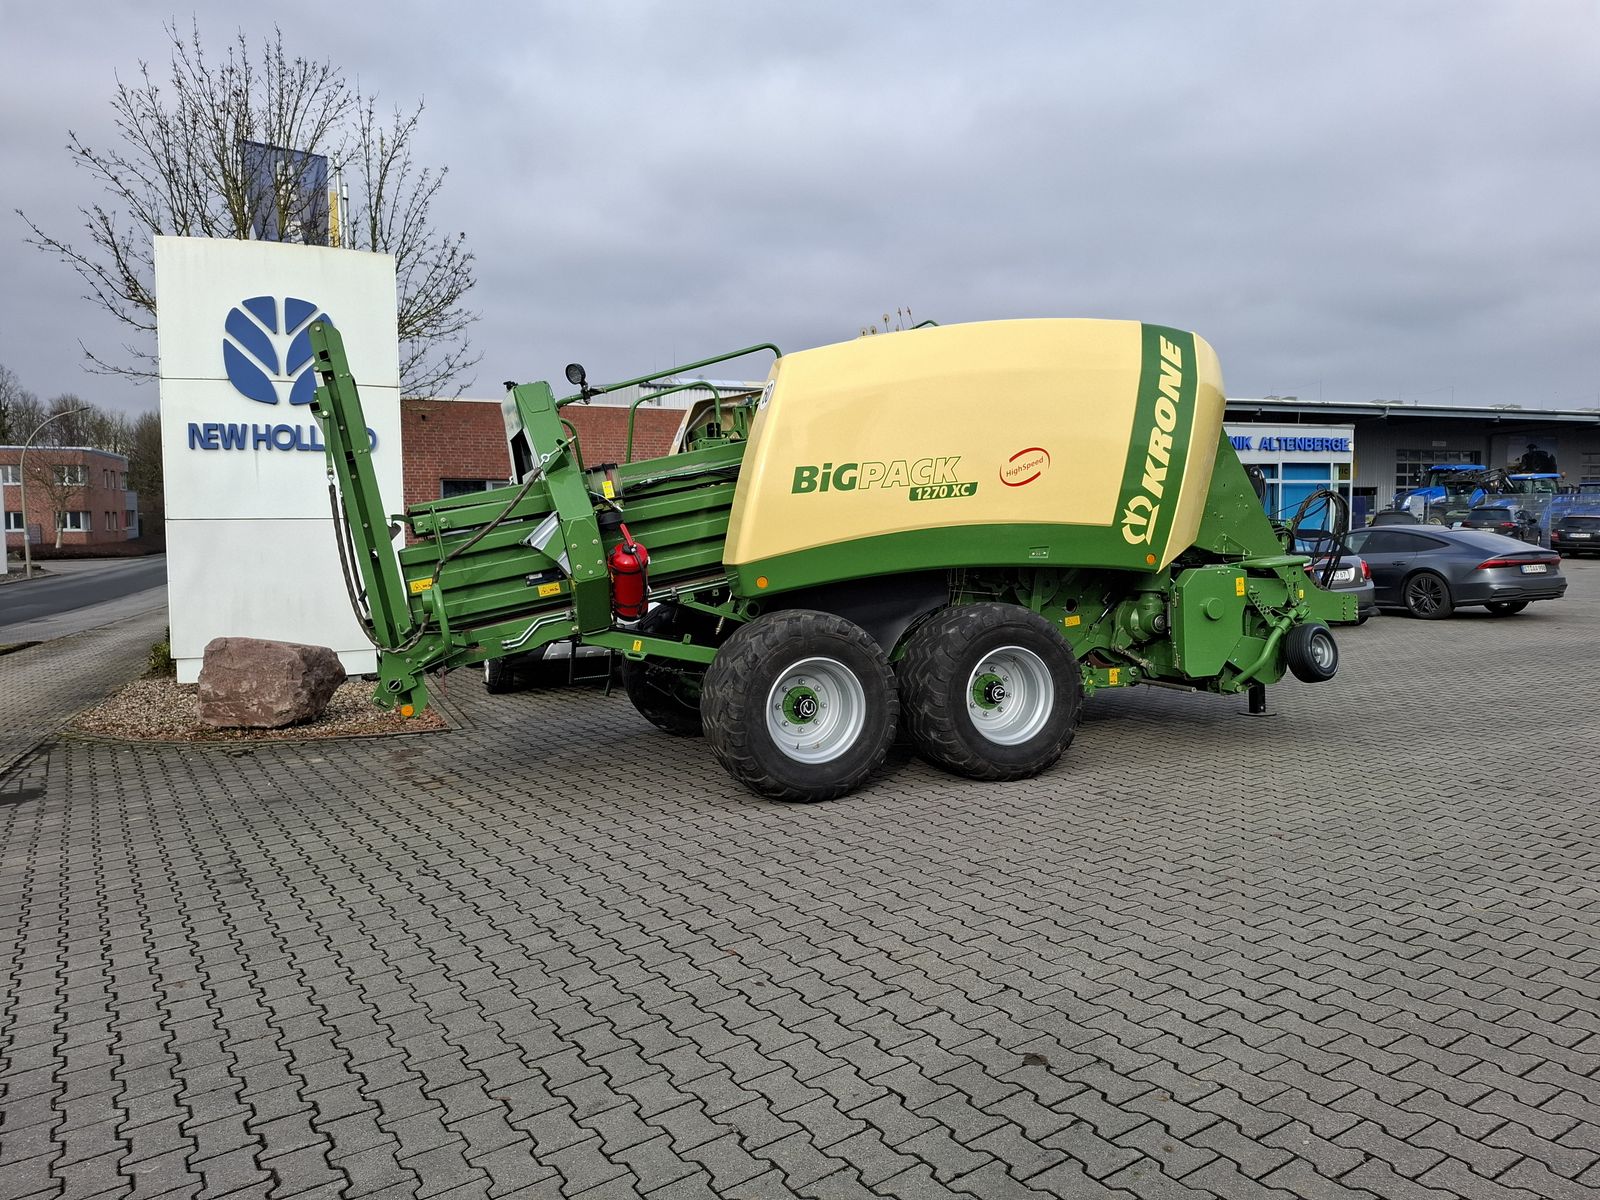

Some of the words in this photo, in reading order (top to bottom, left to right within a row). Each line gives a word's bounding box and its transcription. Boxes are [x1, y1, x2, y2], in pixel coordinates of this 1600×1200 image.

[1141, 335, 1182, 499] KRONE
[187, 422, 247, 451] NEW
[1258, 436, 1350, 452] ALTENBERGE
[1005, 456, 1044, 477] HighSpeed
[915, 487, 947, 500] 1270
[950, 483, 971, 497] XC
